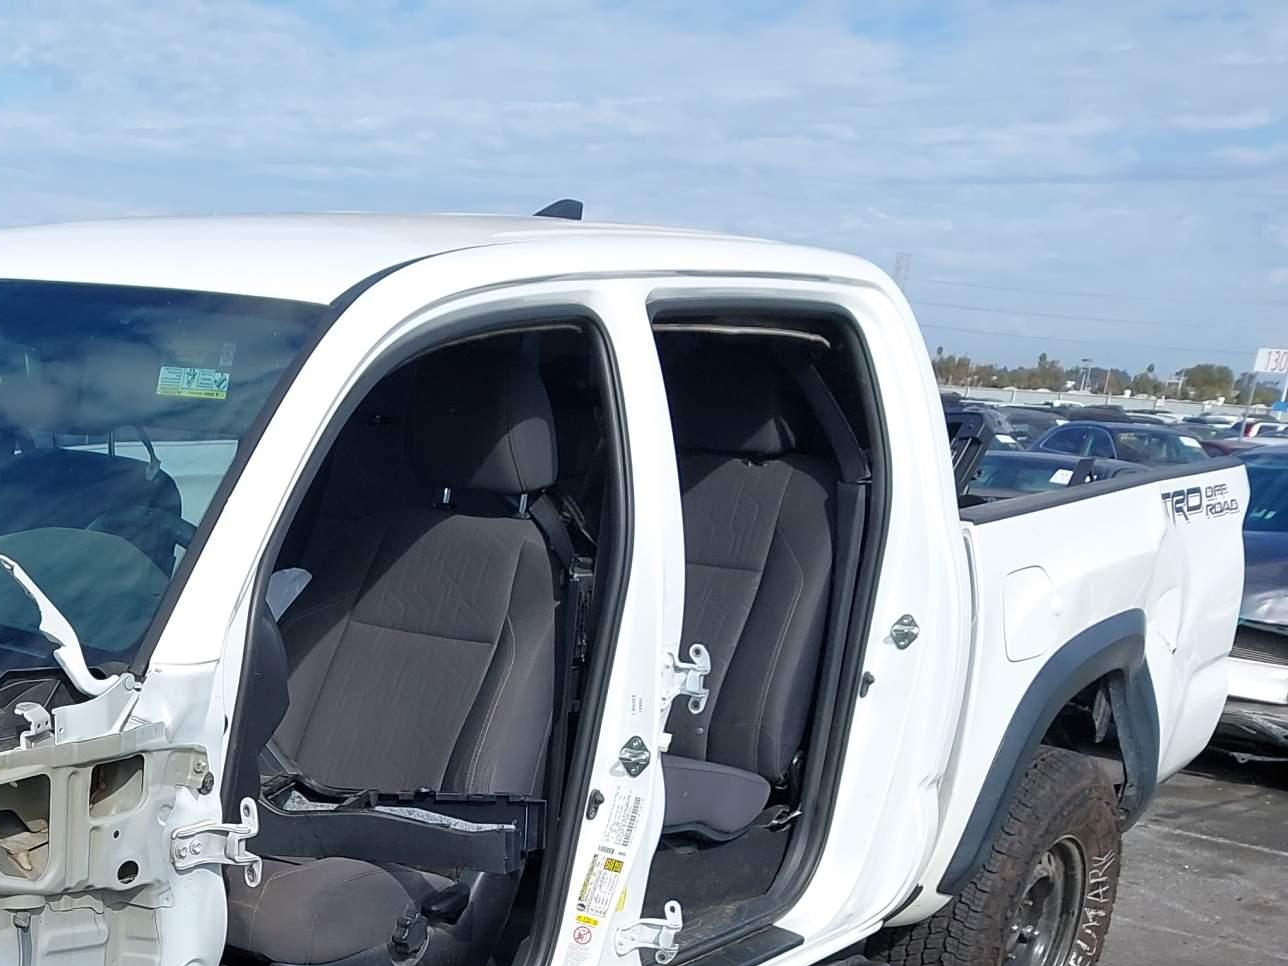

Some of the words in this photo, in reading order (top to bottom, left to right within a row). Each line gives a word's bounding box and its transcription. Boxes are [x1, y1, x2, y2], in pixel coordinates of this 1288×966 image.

[1205, 483, 1228, 500] OFF
[1160, 486, 1203, 527] TRD
[1206, 499, 1239, 518] ROAD
